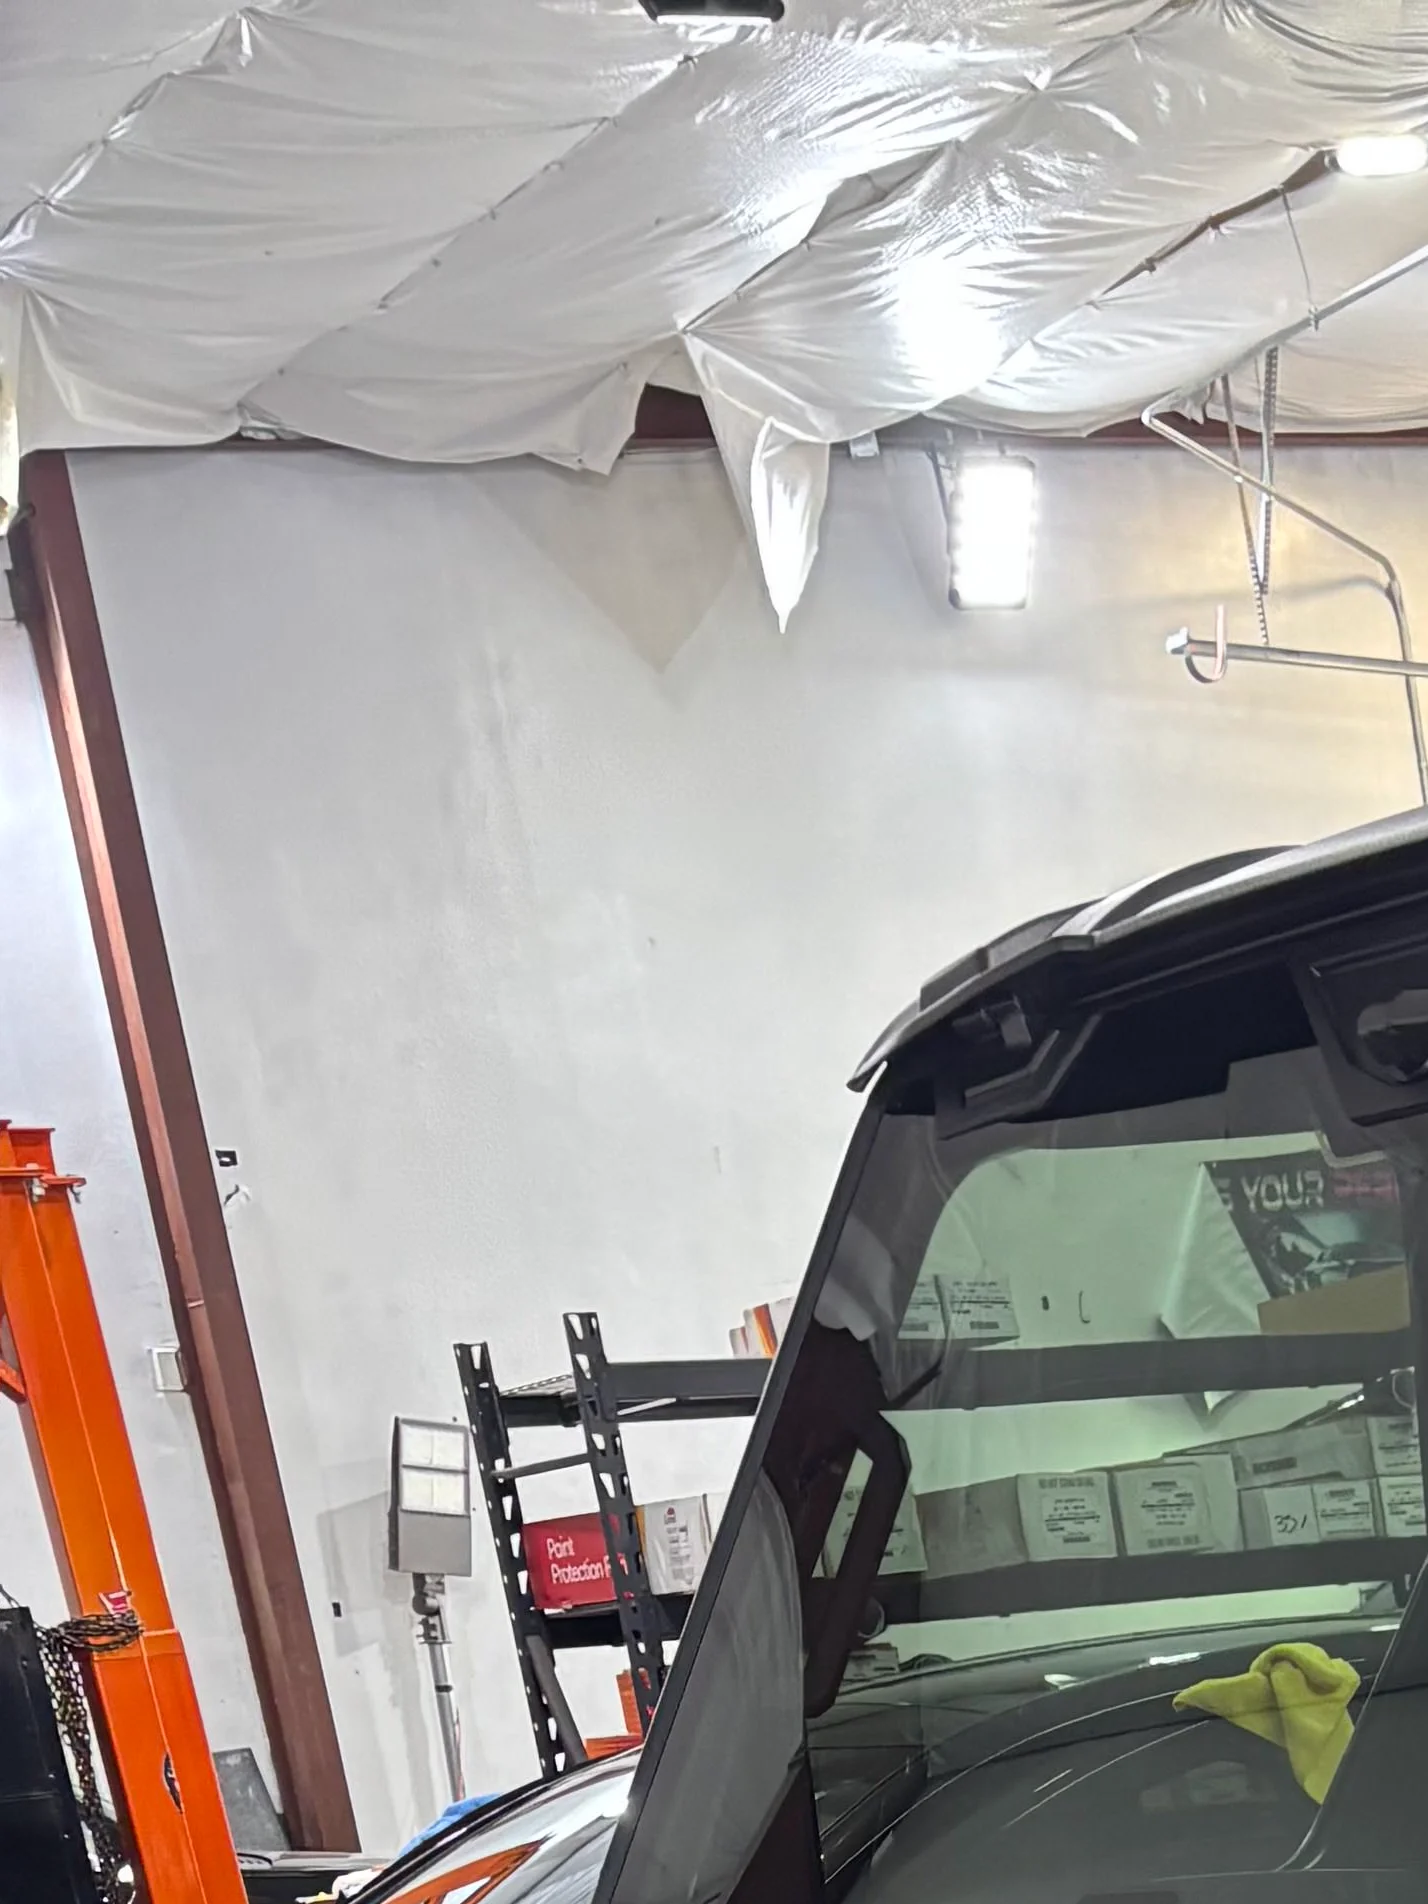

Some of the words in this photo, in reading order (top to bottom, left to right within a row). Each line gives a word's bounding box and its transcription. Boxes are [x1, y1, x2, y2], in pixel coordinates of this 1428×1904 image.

[1240, 1169, 1325, 1213] YOUR
[546, 1535, 576, 1561] Paint
[550, 1555, 603, 1585] Protection
